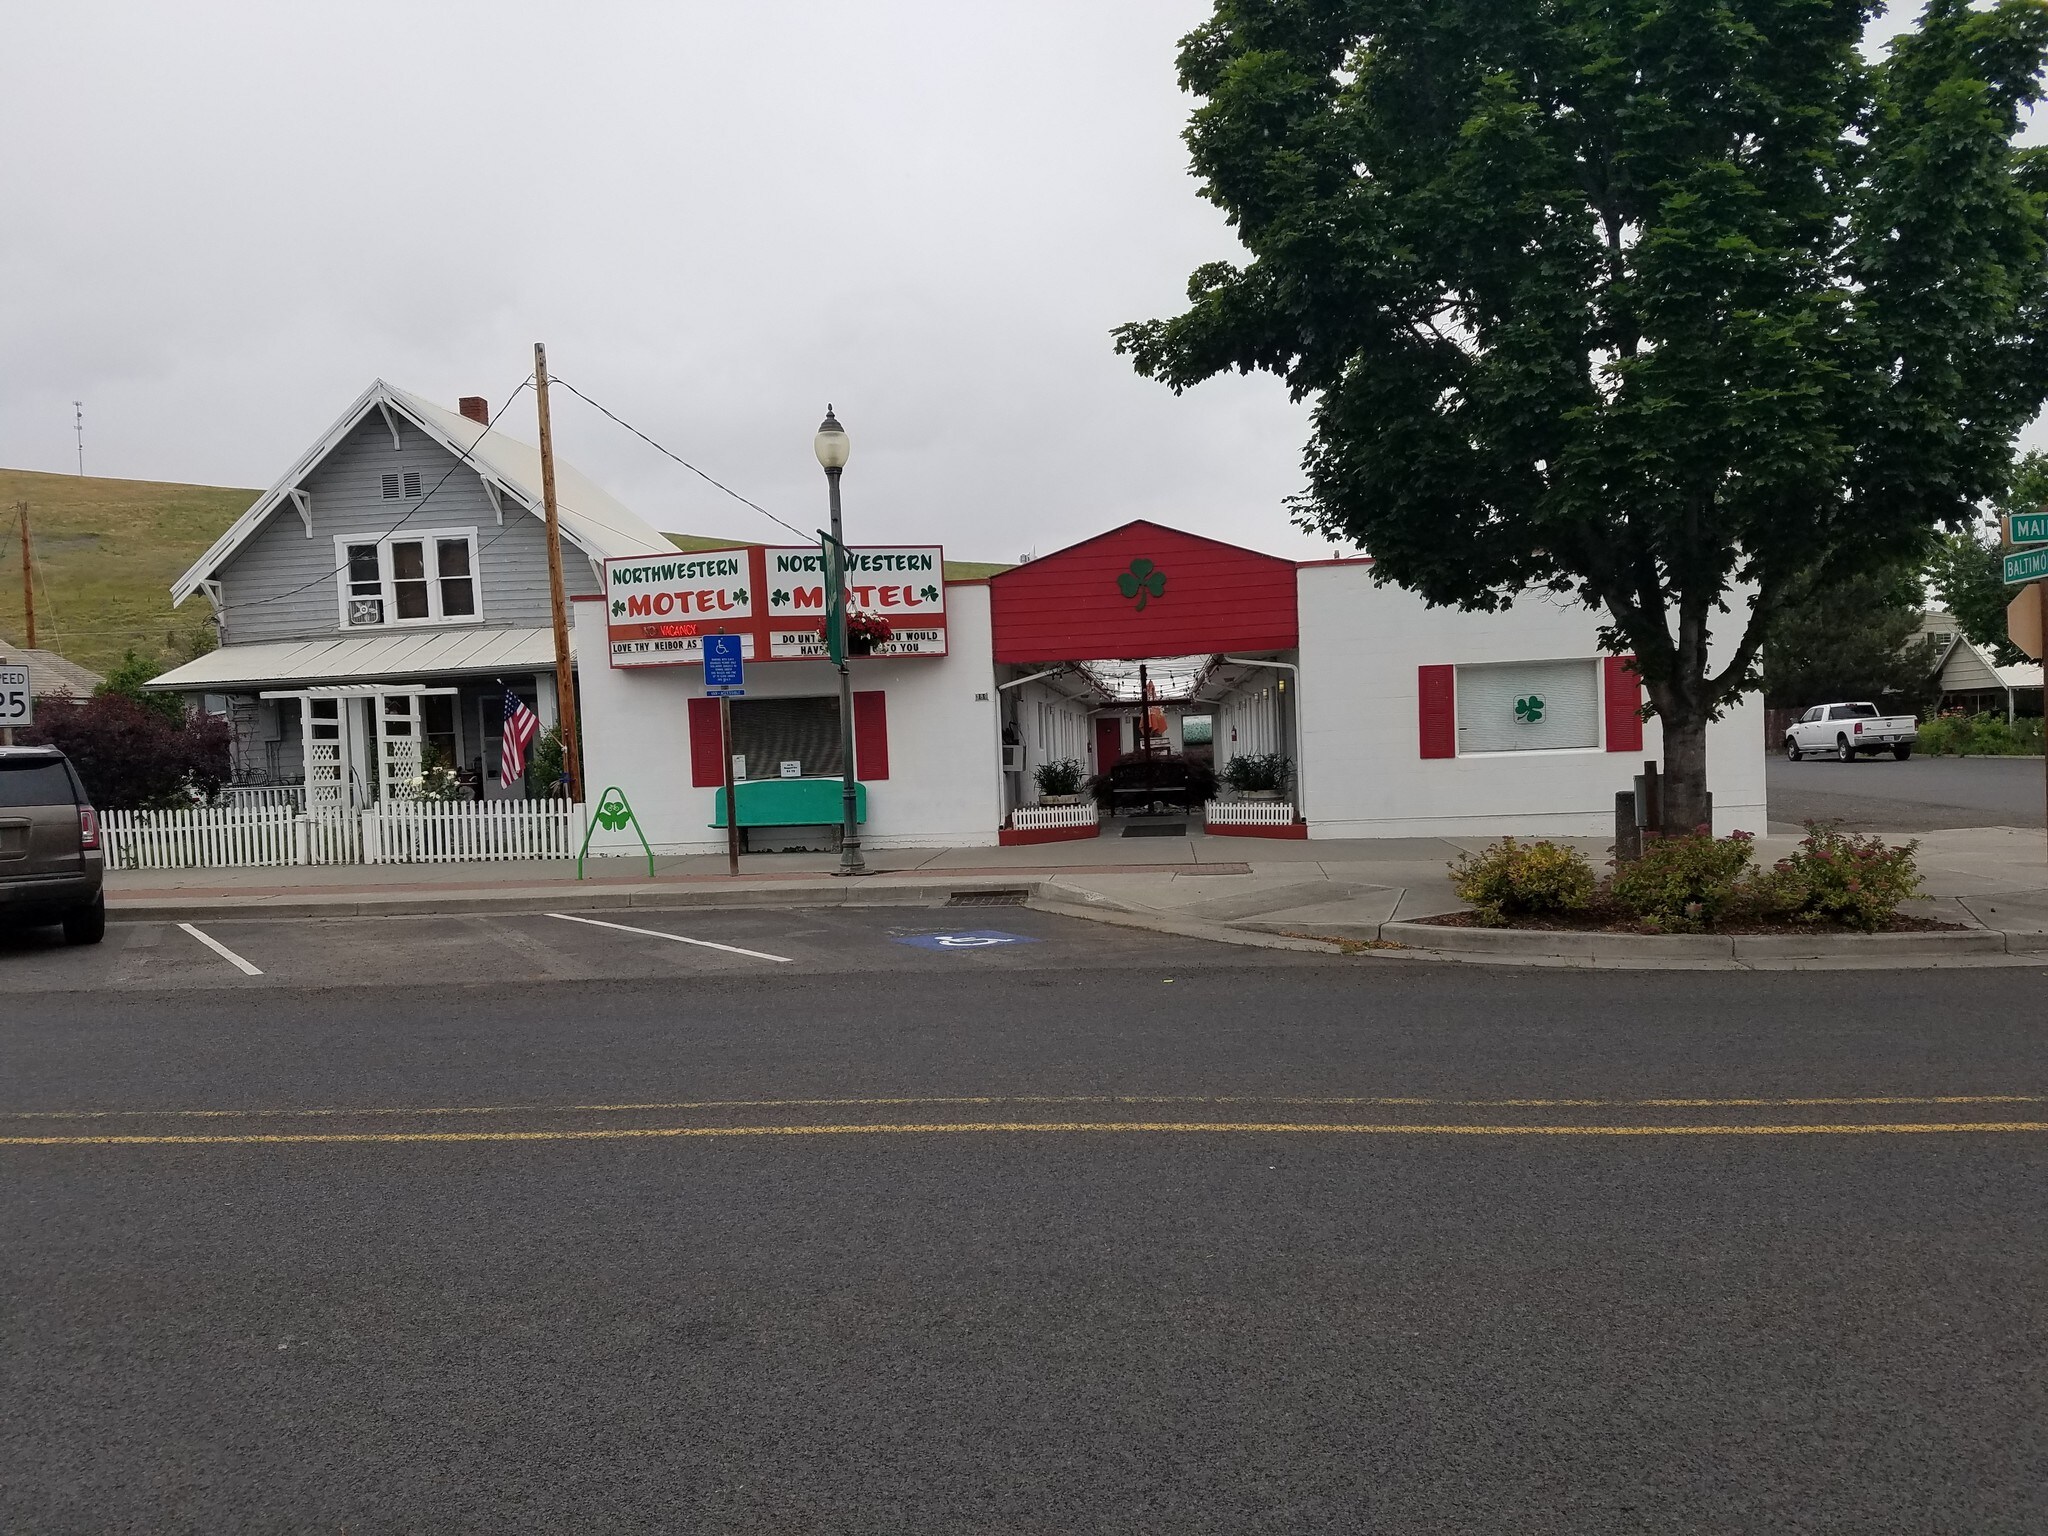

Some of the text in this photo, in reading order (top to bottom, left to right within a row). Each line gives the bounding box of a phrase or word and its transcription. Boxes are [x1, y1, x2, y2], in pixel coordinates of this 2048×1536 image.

[2017, 519, 2048, 537] MAI
[776, 554, 932, 573] NORTWESTERN
[2008, 552, 2048, 577] BALTIMO
[612, 558, 739, 585] NORTHWESTERN
[627, 589, 735, 618] MOTEL
[660, 624, 697, 636] VACANCY
[906, 632, 938, 641] WOULD
[782, 634, 795, 643] DO
[613, 643, 632, 653] LOVE
[634, 642, 650, 652] THY
[655, 640, 684, 651] NEIBOR
[687, 639, 697, 648] AS
[900, 643, 919, 652] YOU
[0, 673, 25, 685] EED
